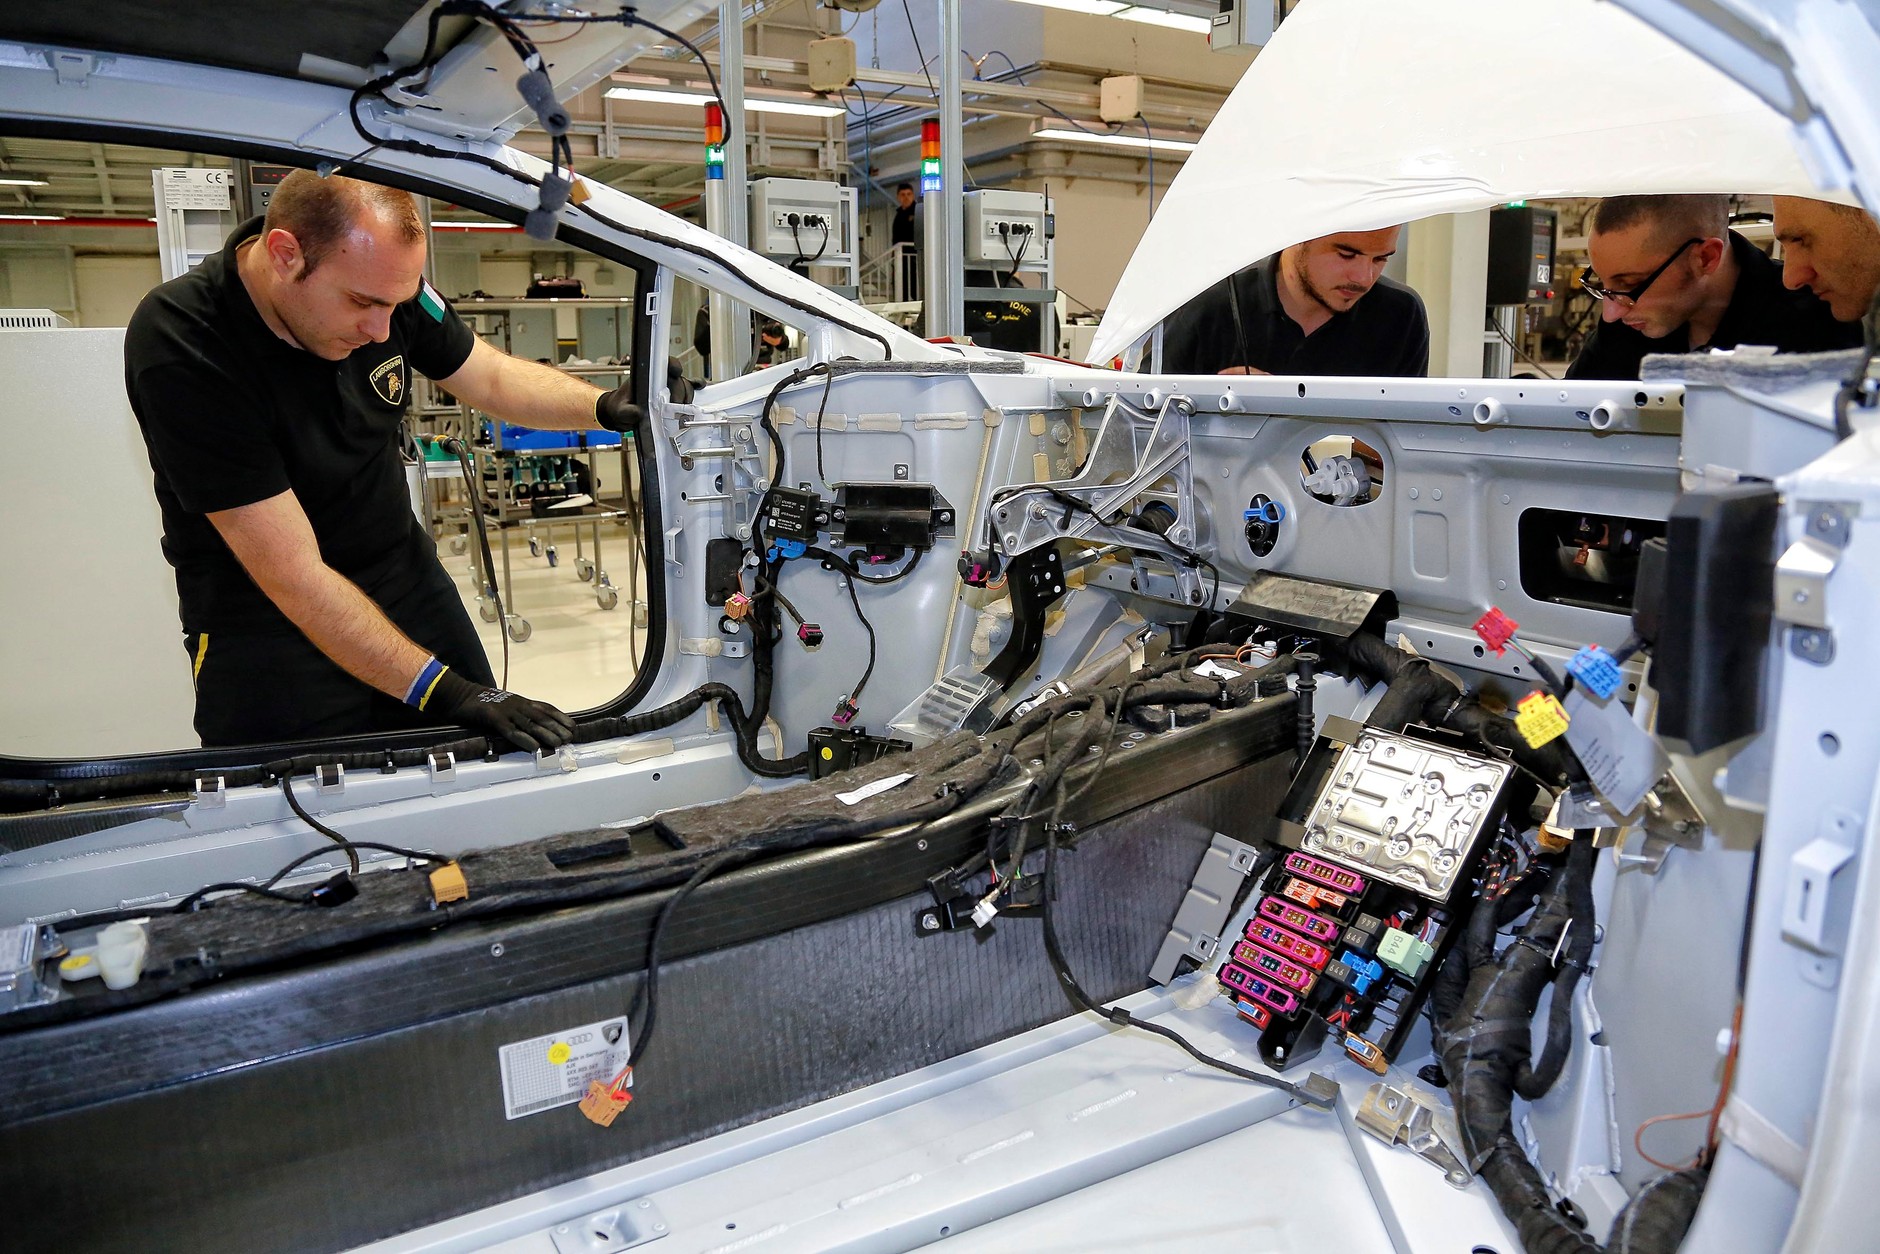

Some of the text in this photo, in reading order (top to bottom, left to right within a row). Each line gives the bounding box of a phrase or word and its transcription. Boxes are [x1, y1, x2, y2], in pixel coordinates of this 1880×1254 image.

[206, 173, 222, 184] CE
[1538, 266, 1549, 282] 23
[373, 358, 401, 382] LAMBORGHINI
[1346, 932, 1362, 943] 646
[1387, 935, 1404, 956] 644
[1329, 964, 1344, 976] 646
